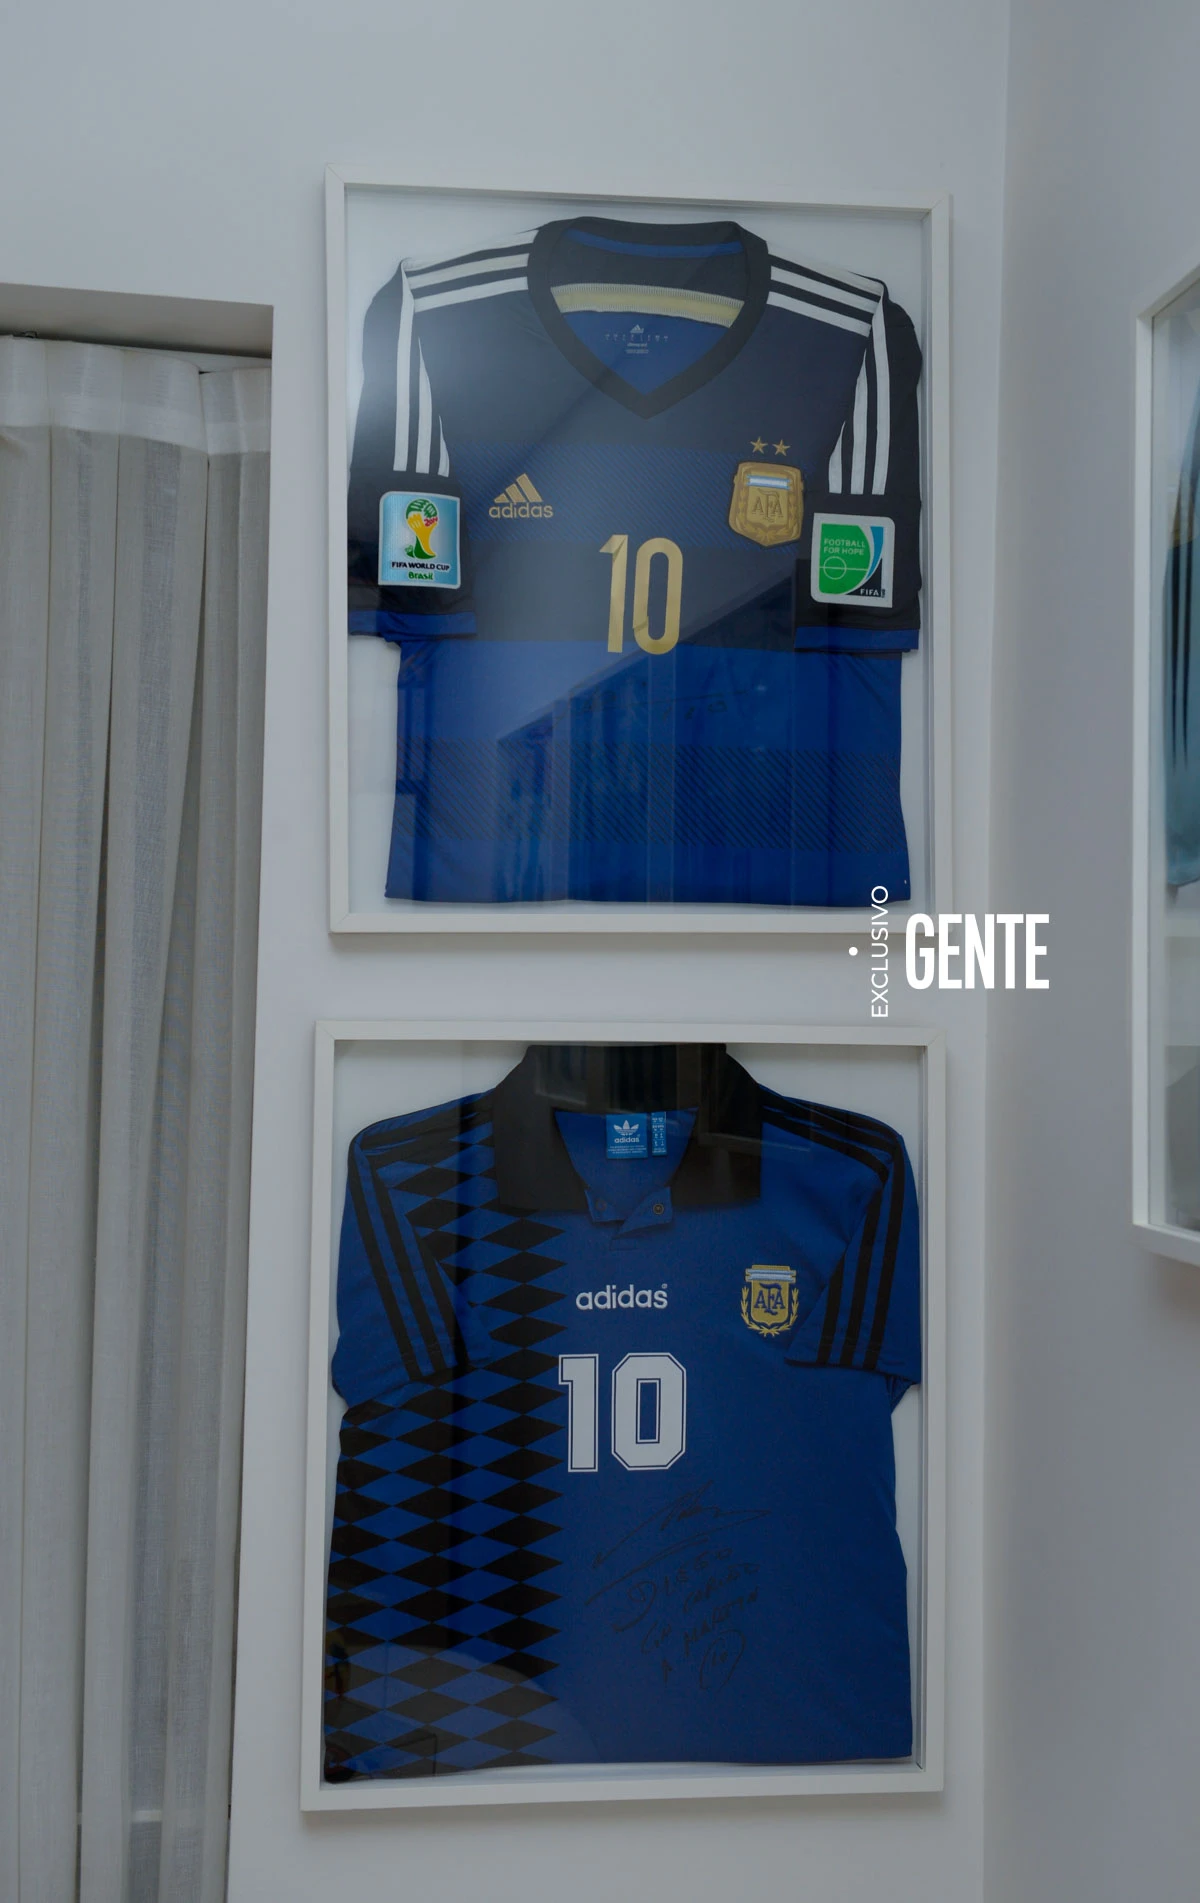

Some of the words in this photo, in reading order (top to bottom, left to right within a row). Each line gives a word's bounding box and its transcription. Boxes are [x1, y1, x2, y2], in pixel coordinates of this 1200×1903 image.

[489, 503, 554, 518] adidas
[752, 488, 784, 523] AFA
[823, 538, 866, 548] FOOTBALL
[842, 548, 865, 556] HOPE
[408, 562, 436, 570] WORLD
[436, 563, 450, 571] CUP
[599, 534, 684, 655] 10
[860, 588, 880, 596] FIFA
[576, 1284, 668, 1310] adidas
[754, 1282, 785, 1316] AFA
[558, 1352, 687, 1473] 10
